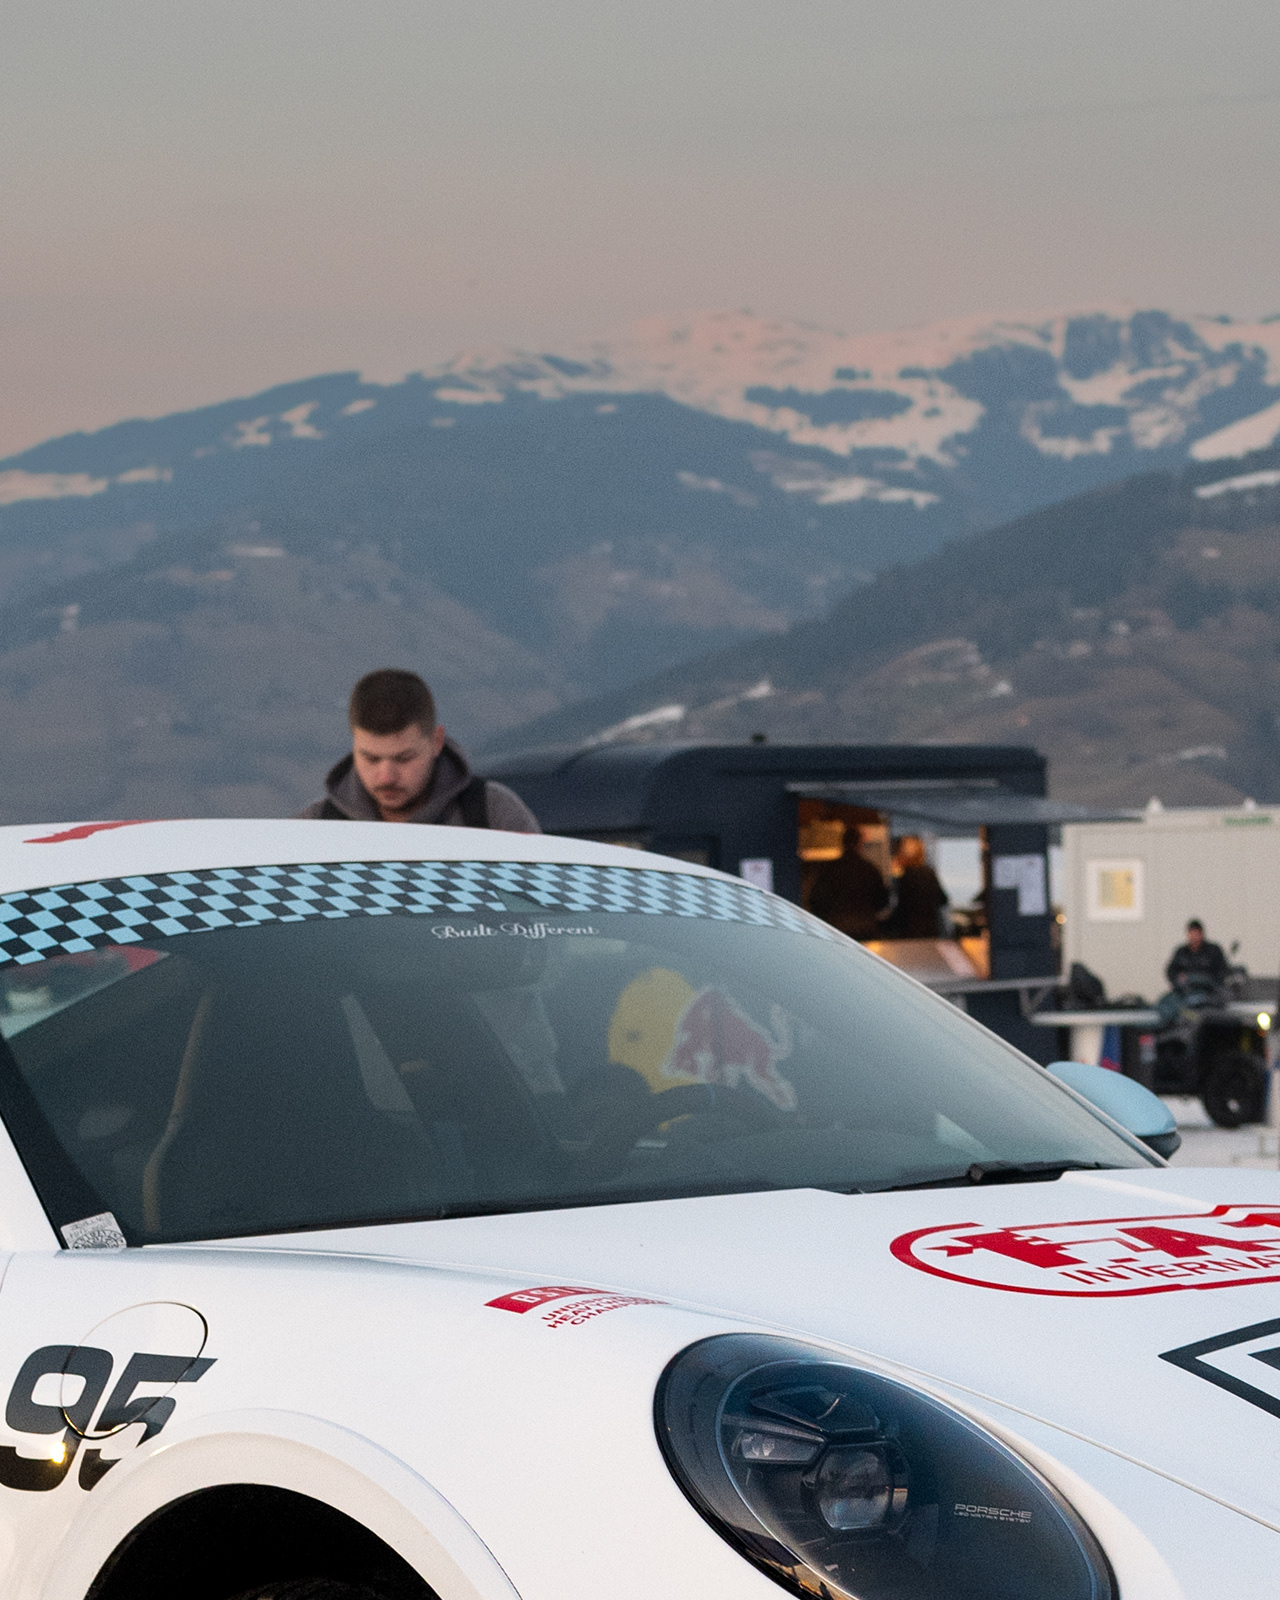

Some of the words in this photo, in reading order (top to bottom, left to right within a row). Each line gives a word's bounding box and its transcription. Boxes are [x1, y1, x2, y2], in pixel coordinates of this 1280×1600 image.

[431, 923, 498, 940] Built
[500, 922, 600, 940] Different
[954, 1503, 1033, 1519] PORSCHE
